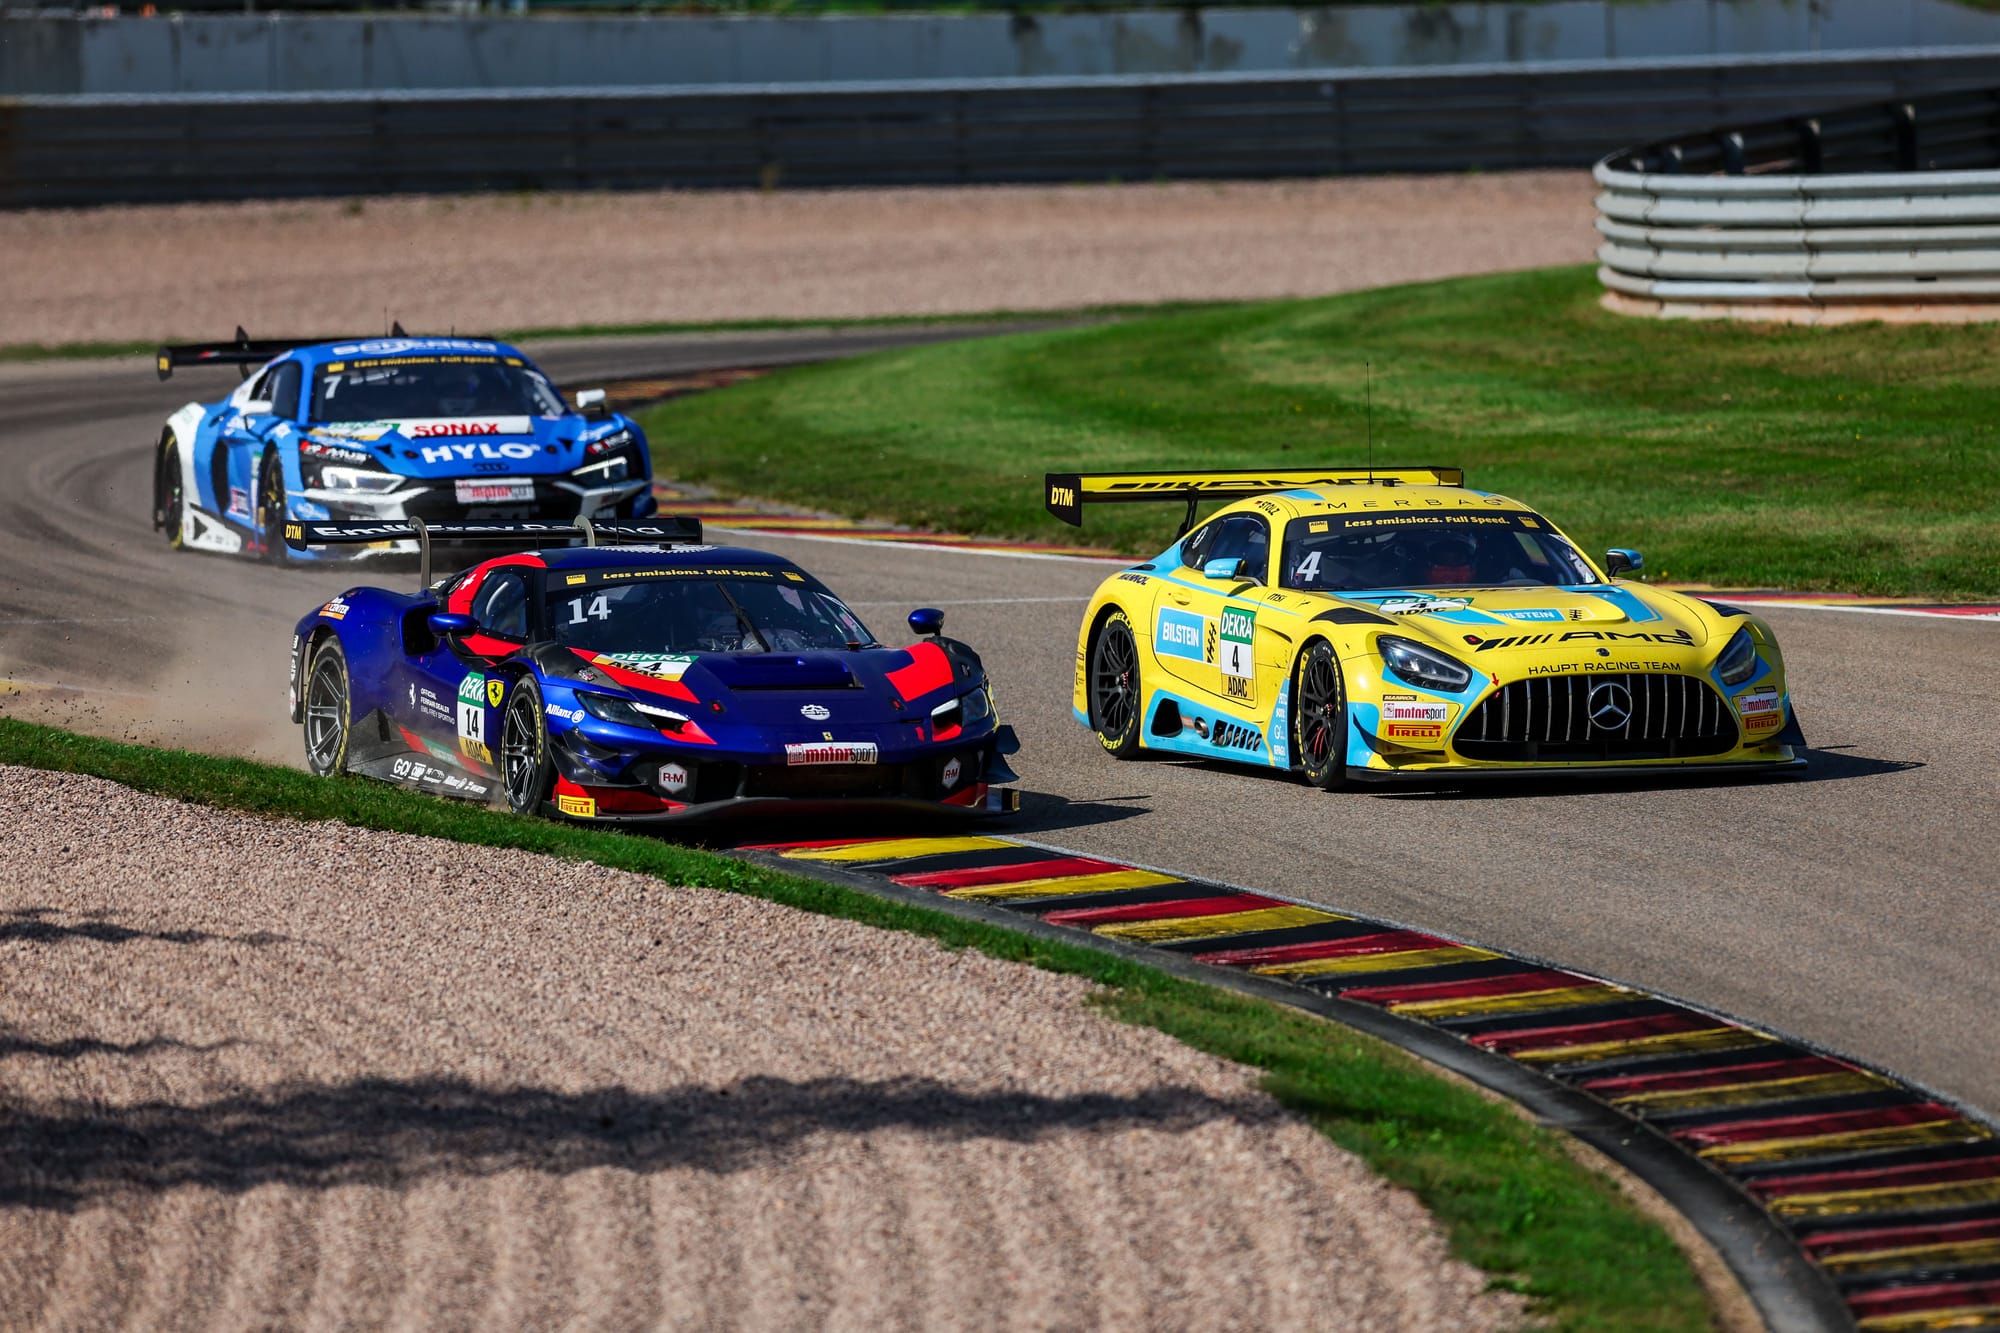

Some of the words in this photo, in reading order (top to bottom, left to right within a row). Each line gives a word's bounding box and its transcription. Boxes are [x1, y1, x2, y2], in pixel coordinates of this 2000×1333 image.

[323, 375, 343, 400] 7
[414, 423, 499, 438] SONAX
[1051, 487, 1074, 507] DTM
[1327, 499, 1505, 510] MERBAG
[1258, 501, 1280, 516] STOLZ
[1345, 519, 1373, 528] Less
[1375, 516, 1443, 526] emissions.
[1445, 515, 1468, 523] Full
[1469, 516, 1511, 525] Speed.
[285, 524, 302, 540] DTM
[634, 569, 704, 578] emissions.
[705, 568, 730, 576] Full
[732, 569, 773, 578] Speed.
[1295, 551, 1322, 582] 4
[567, 595, 612, 627] 14
[1392, 607, 1447, 616] ADAC
[1221, 611, 1253, 640] DEKRA
[1162, 621, 1200, 648] BILSTEIN
[1558, 629, 1697, 647] AMG
[610, 653, 692, 662] DEKRA
[1231, 645, 1240, 673] 4
[1528, 664, 1579, 676] HAUPT
[1584, 661, 1640, 672] RACING
[1643, 661, 1681, 671] TEAM
[1227, 676, 1248, 698] ADAC
[544, 703, 573, 719] Allianz
[1394, 707, 1446, 721] motorsport
[465, 707, 479, 738] 14
[1746, 714, 1778, 730] PIRELLI
[1388, 724, 1441, 737] PIRELLI
[805, 745, 876, 764] motorsport
[663, 772, 685, 784] R-M
[560, 798, 591, 814] PIRELLI
